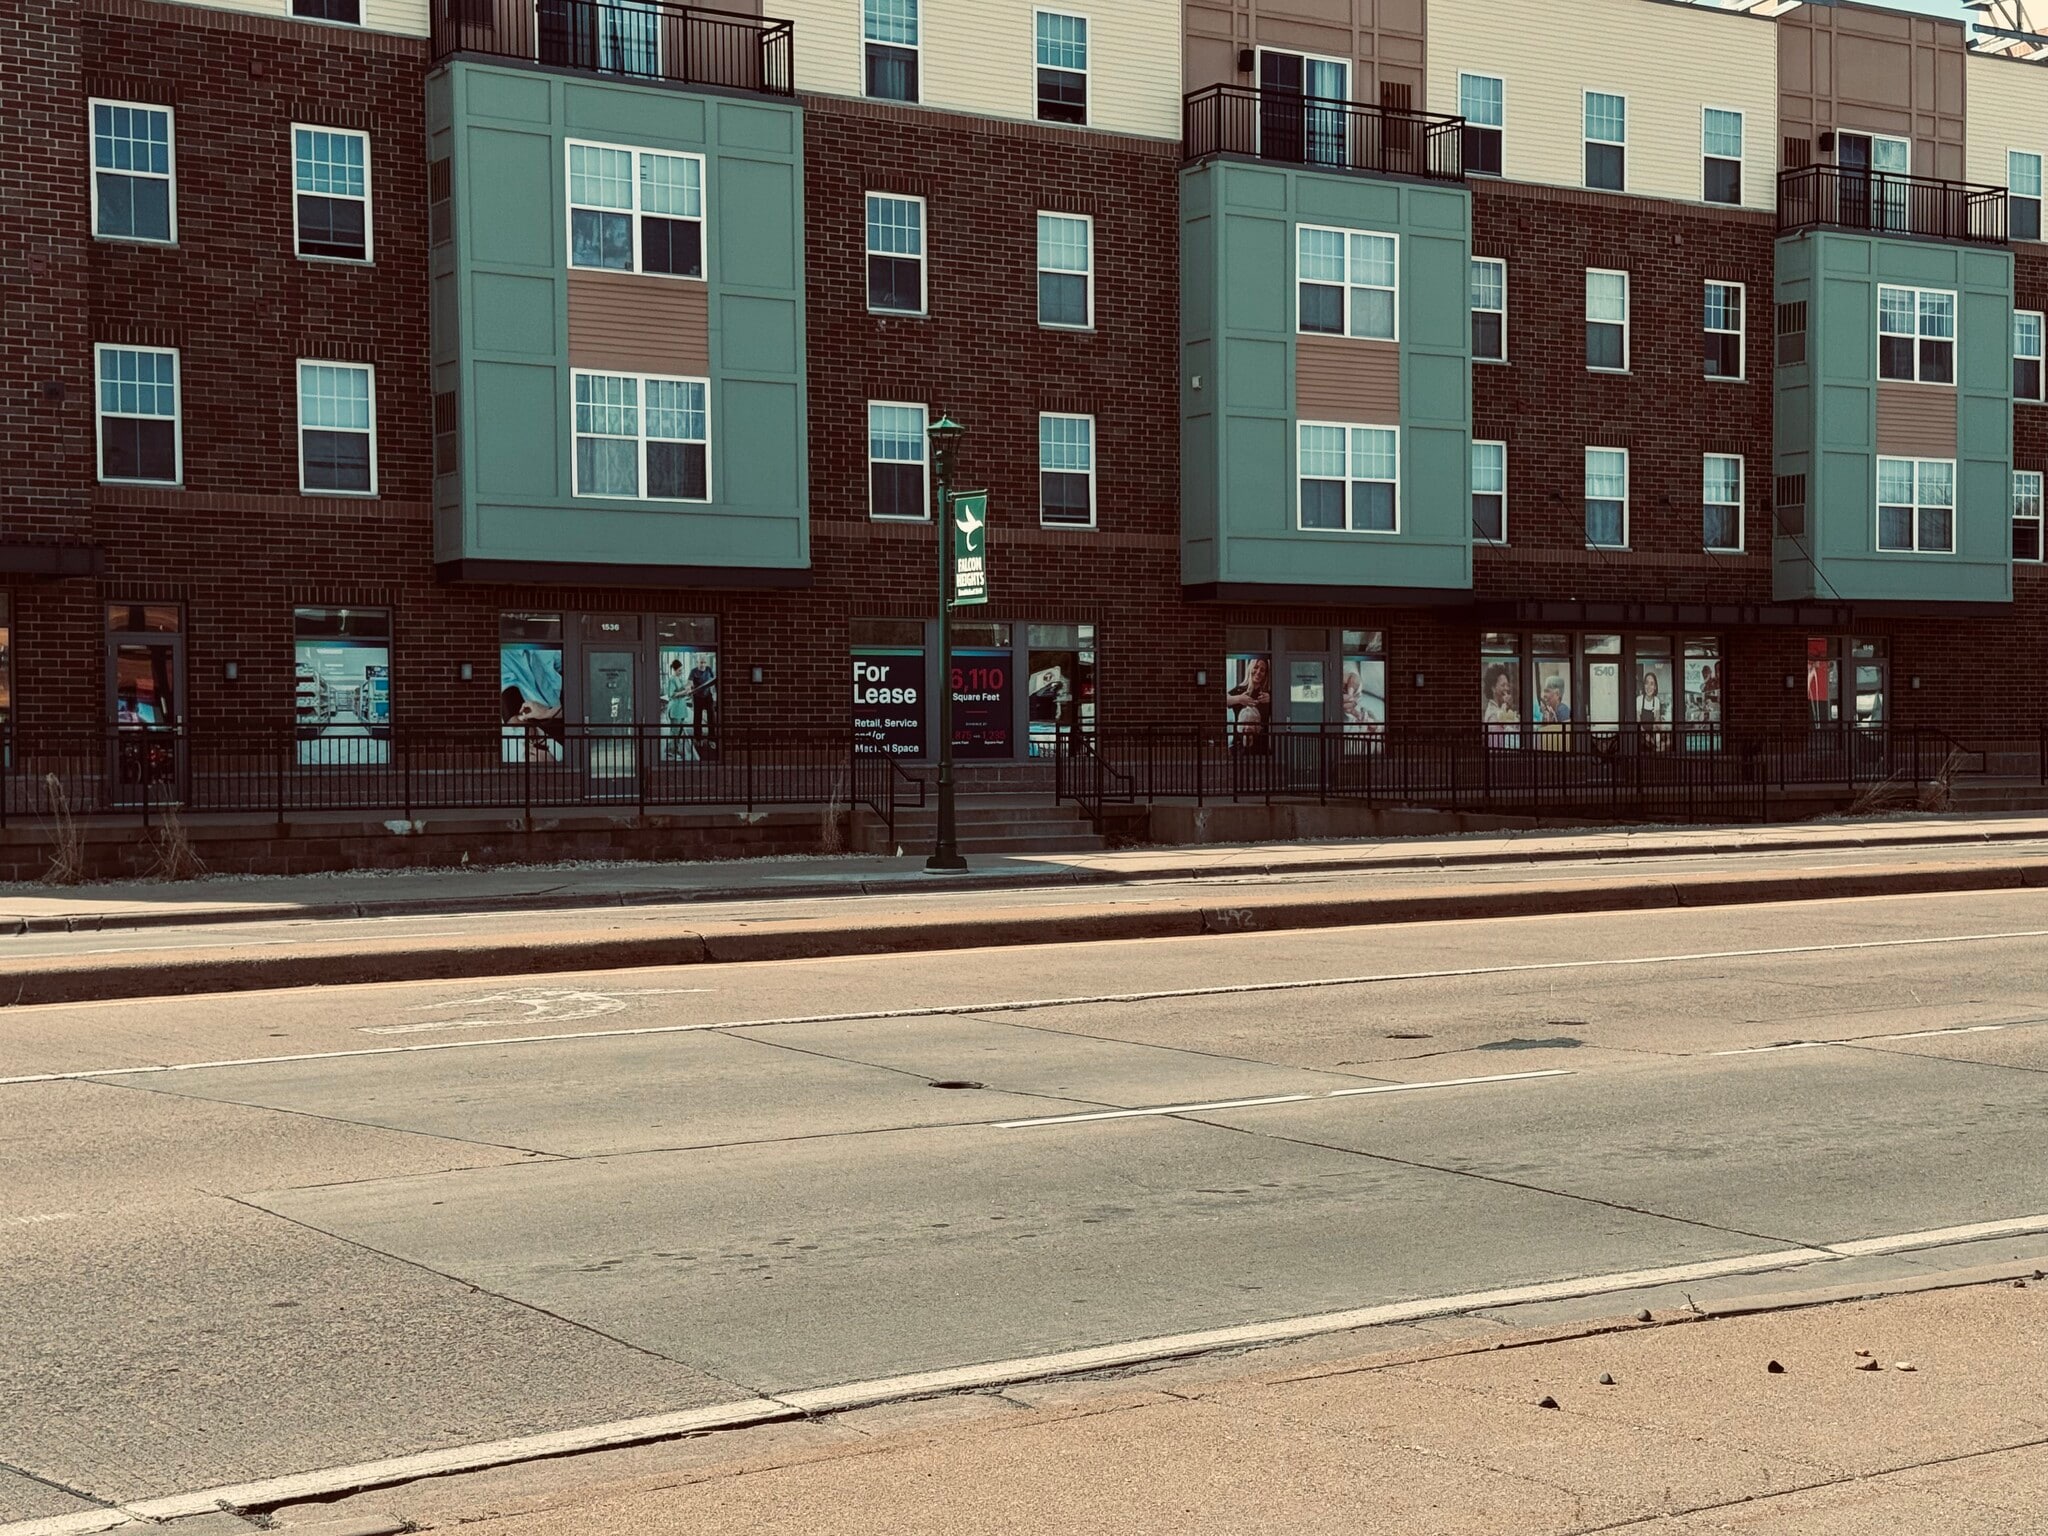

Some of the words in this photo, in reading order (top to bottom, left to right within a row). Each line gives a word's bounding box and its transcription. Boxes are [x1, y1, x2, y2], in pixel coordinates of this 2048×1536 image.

[957, 557, 982, 573] FALCON
[956, 572, 985, 587] HEIGHTS
[853, 661, 890, 682] For
[951, 668, 1003, 693] 6,110
[853, 683, 917, 704] Lease
[952, 692, 981, 703] Square
[982, 692, 1000, 702] Feet
[854, 718, 883, 728] Retail,
[884, 718, 918, 728] Service
[891, 744, 919, 755] Space
